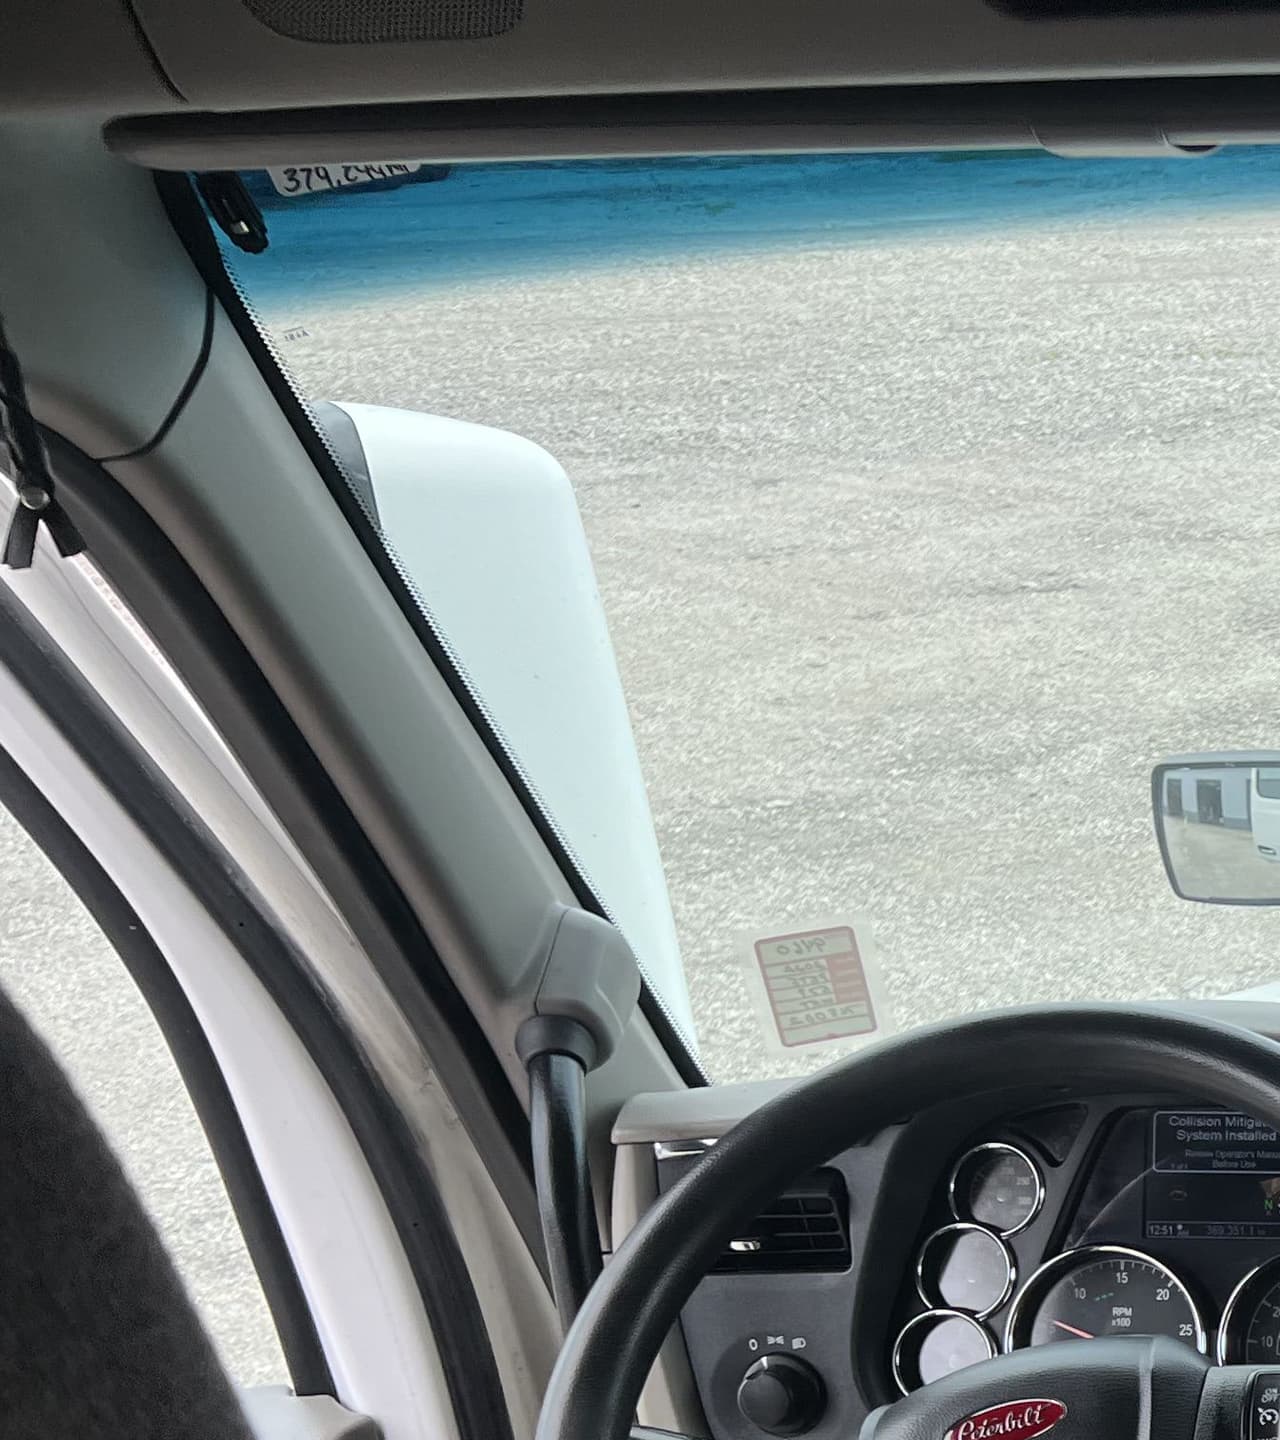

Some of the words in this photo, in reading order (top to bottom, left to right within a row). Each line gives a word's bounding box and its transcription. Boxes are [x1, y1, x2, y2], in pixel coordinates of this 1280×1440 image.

[1169, 1116, 1221, 1127] Collision
[1176, 1130, 1222, 1142] System
[1225, 1130, 1277, 1141] Installed
[1116, 1272, 1128, 1283] 15
[1074, 1288, 1086, 1299] 10
[1156, 1289, 1169, 1300] 20
[1112, 1307, 1132, 1317] RPM
[1179, 1324, 1192, 1336] 25
[1262, 1336, 1273, 1347] 10
